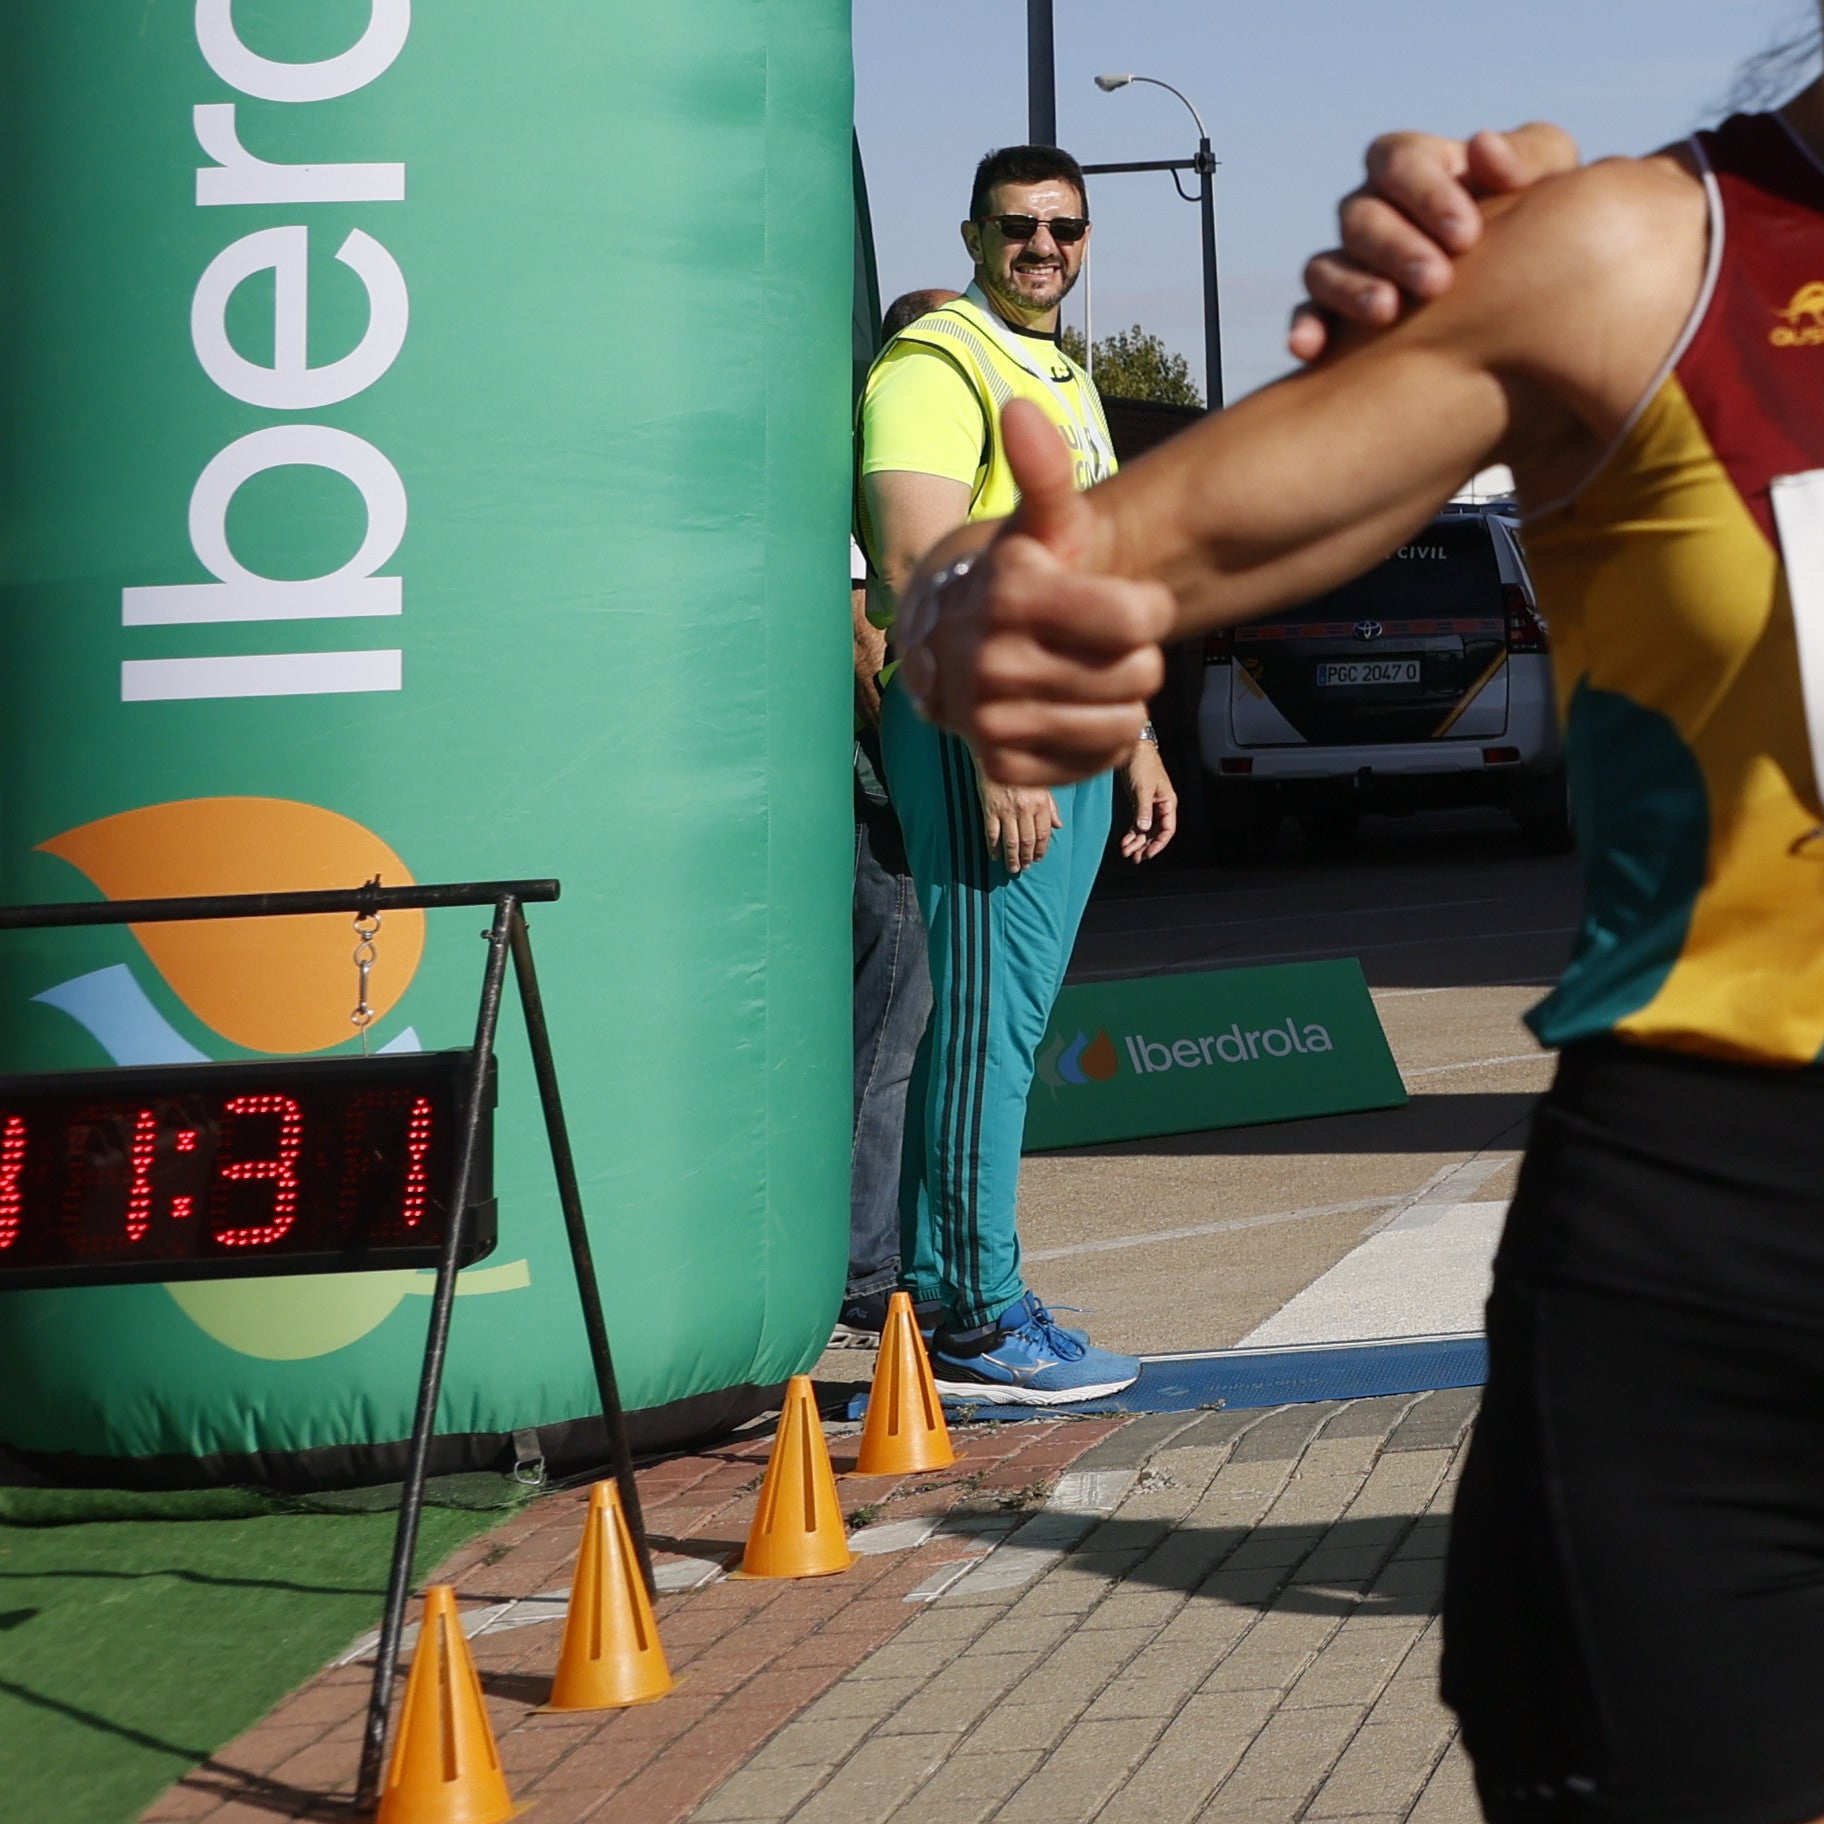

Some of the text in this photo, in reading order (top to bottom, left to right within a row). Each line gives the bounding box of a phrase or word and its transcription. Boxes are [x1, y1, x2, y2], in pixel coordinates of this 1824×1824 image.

[1397, 546, 1448, 560] CIVIL
[1327, 666, 1357, 683] PGC
[1362, 664, 1401, 682] 2047
[1124, 1017, 1334, 1075] Iberdrola
